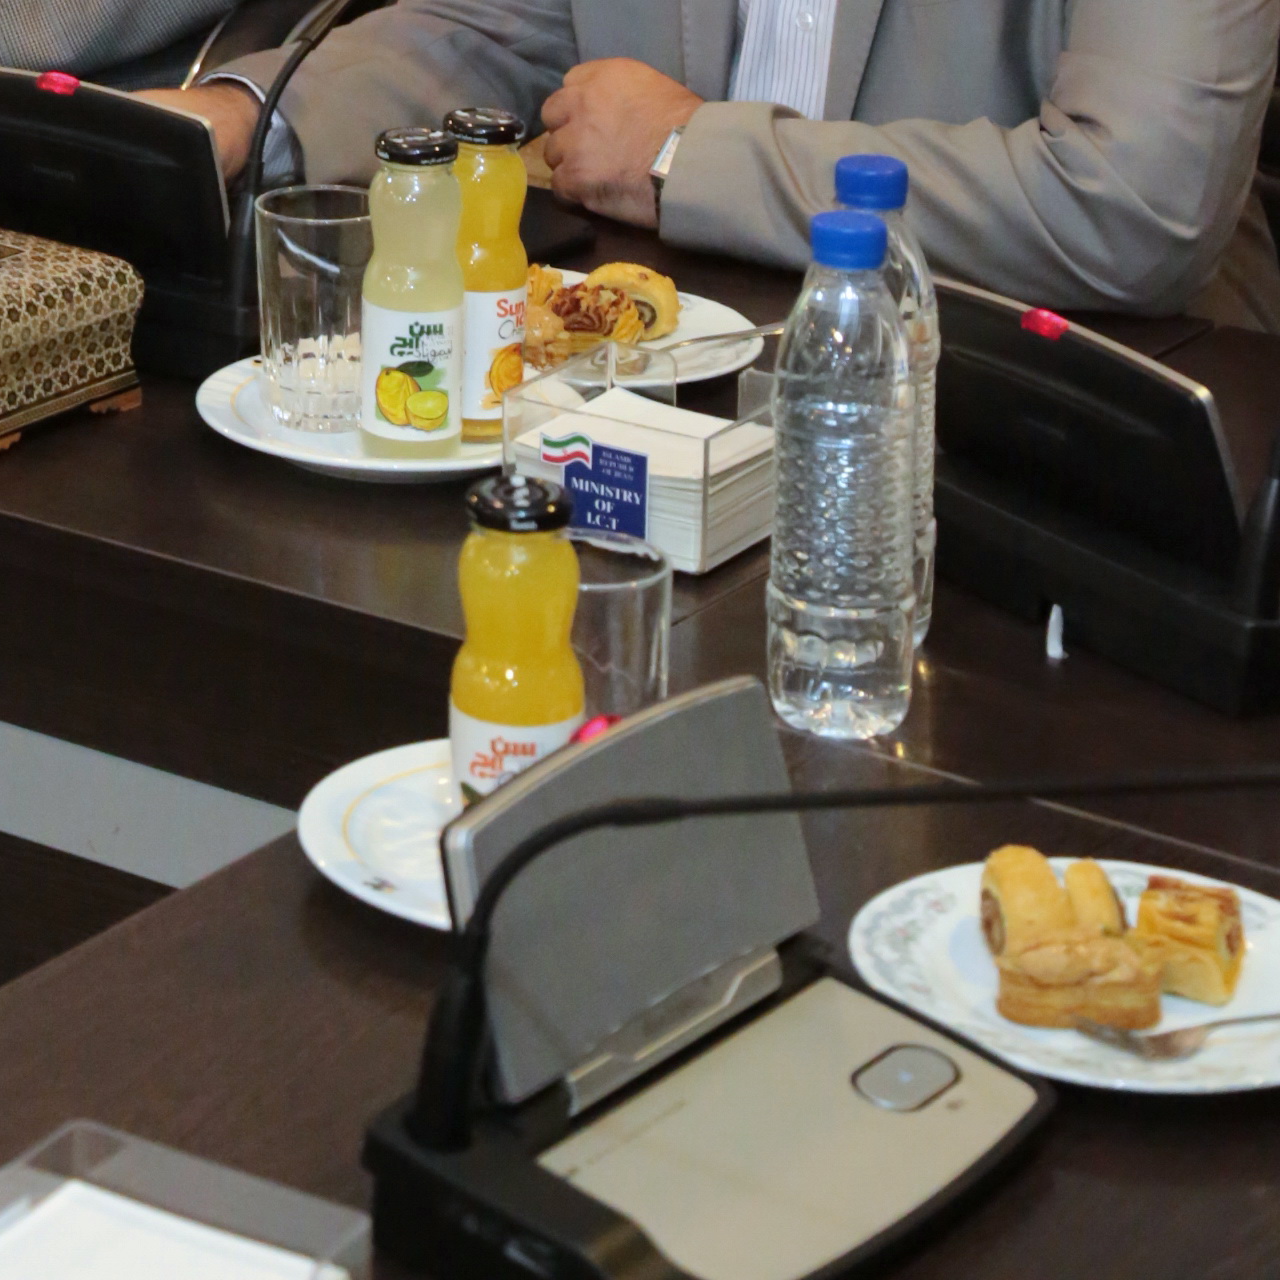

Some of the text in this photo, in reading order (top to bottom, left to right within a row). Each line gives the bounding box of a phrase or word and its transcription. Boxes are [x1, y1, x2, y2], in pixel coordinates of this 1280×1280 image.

[571, 476, 643, 506] MINISTRY
[594, 499, 615, 514] OF
[586, 511, 619, 531] I.C.T
